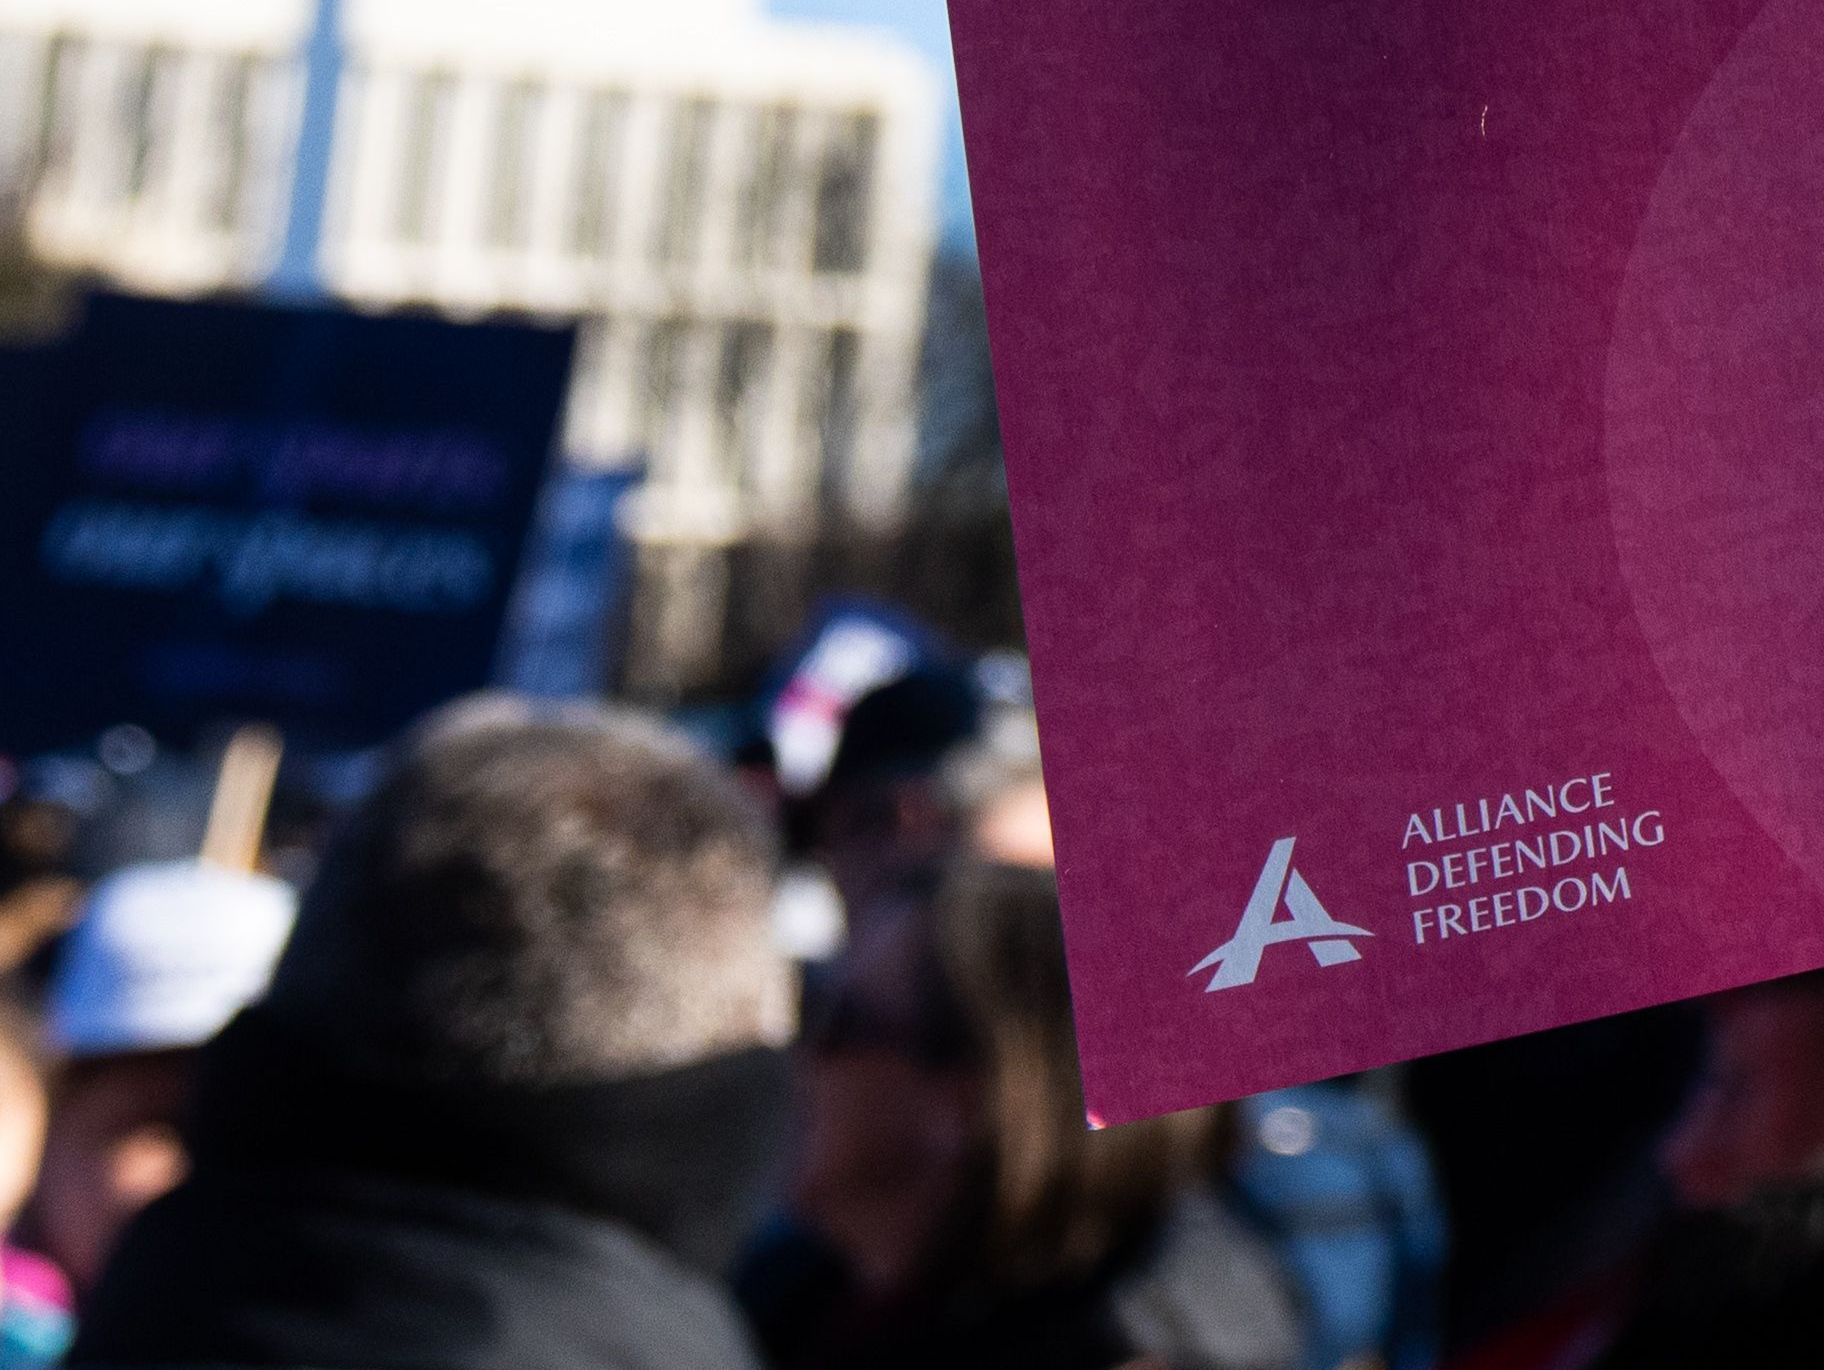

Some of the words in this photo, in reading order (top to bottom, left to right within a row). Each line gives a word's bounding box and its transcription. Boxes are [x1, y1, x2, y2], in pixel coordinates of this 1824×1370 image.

[1402, 772, 1615, 849] ALLIANCE
[1407, 810, 1665, 896] DEFENDING
[1413, 866, 1631, 944] FREEDOM
